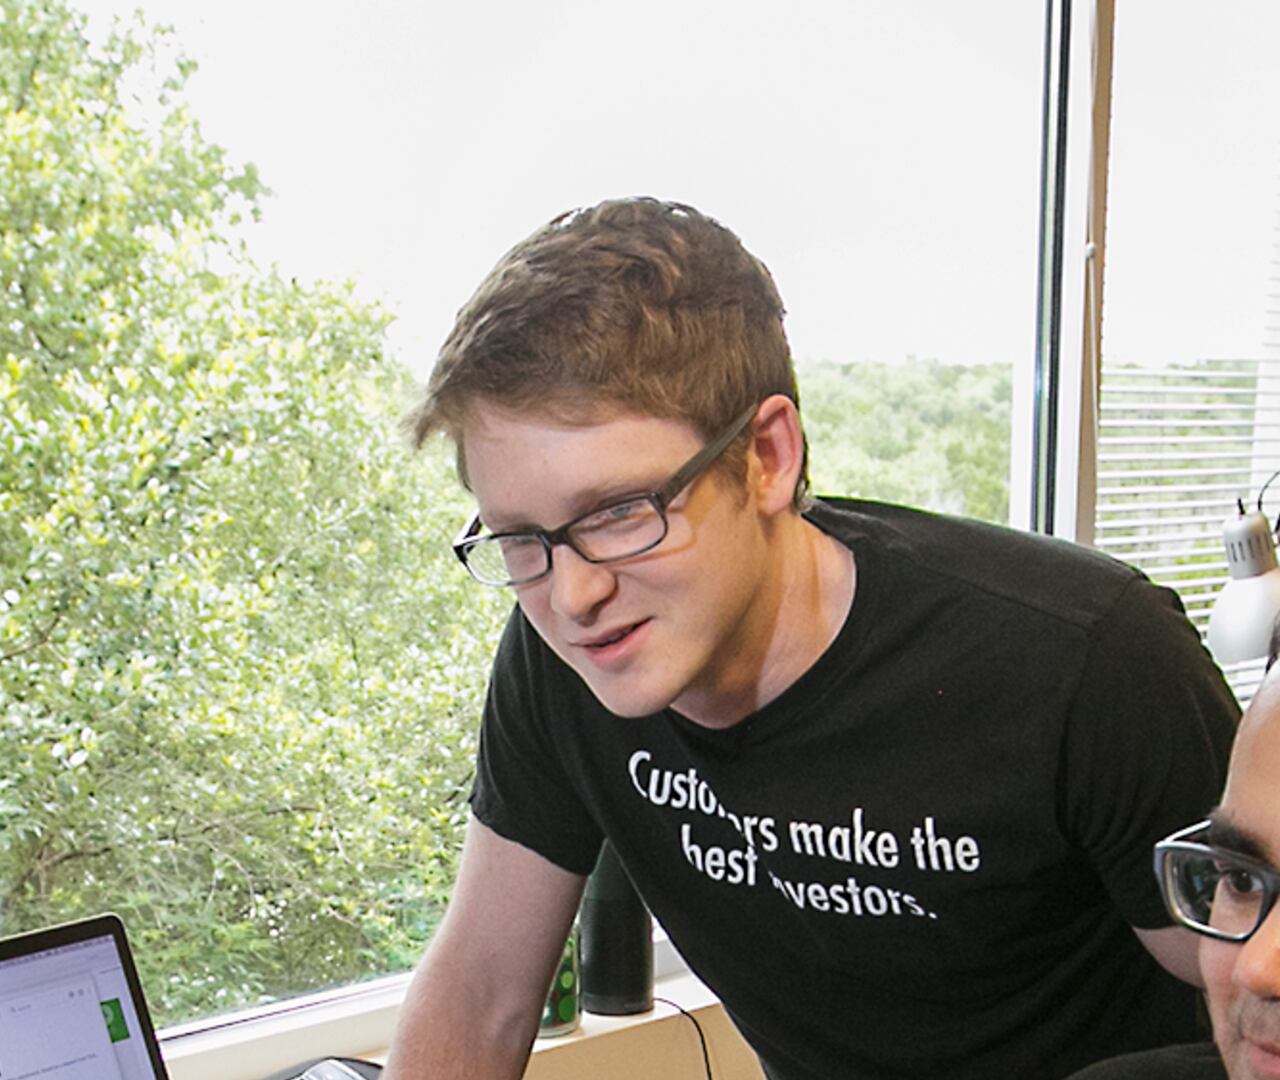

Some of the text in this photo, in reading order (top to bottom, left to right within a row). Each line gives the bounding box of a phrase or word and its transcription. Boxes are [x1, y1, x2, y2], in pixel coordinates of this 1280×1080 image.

[627, 749, 981, 872] Custors make the
[767, 871, 938, 920] vestors.
